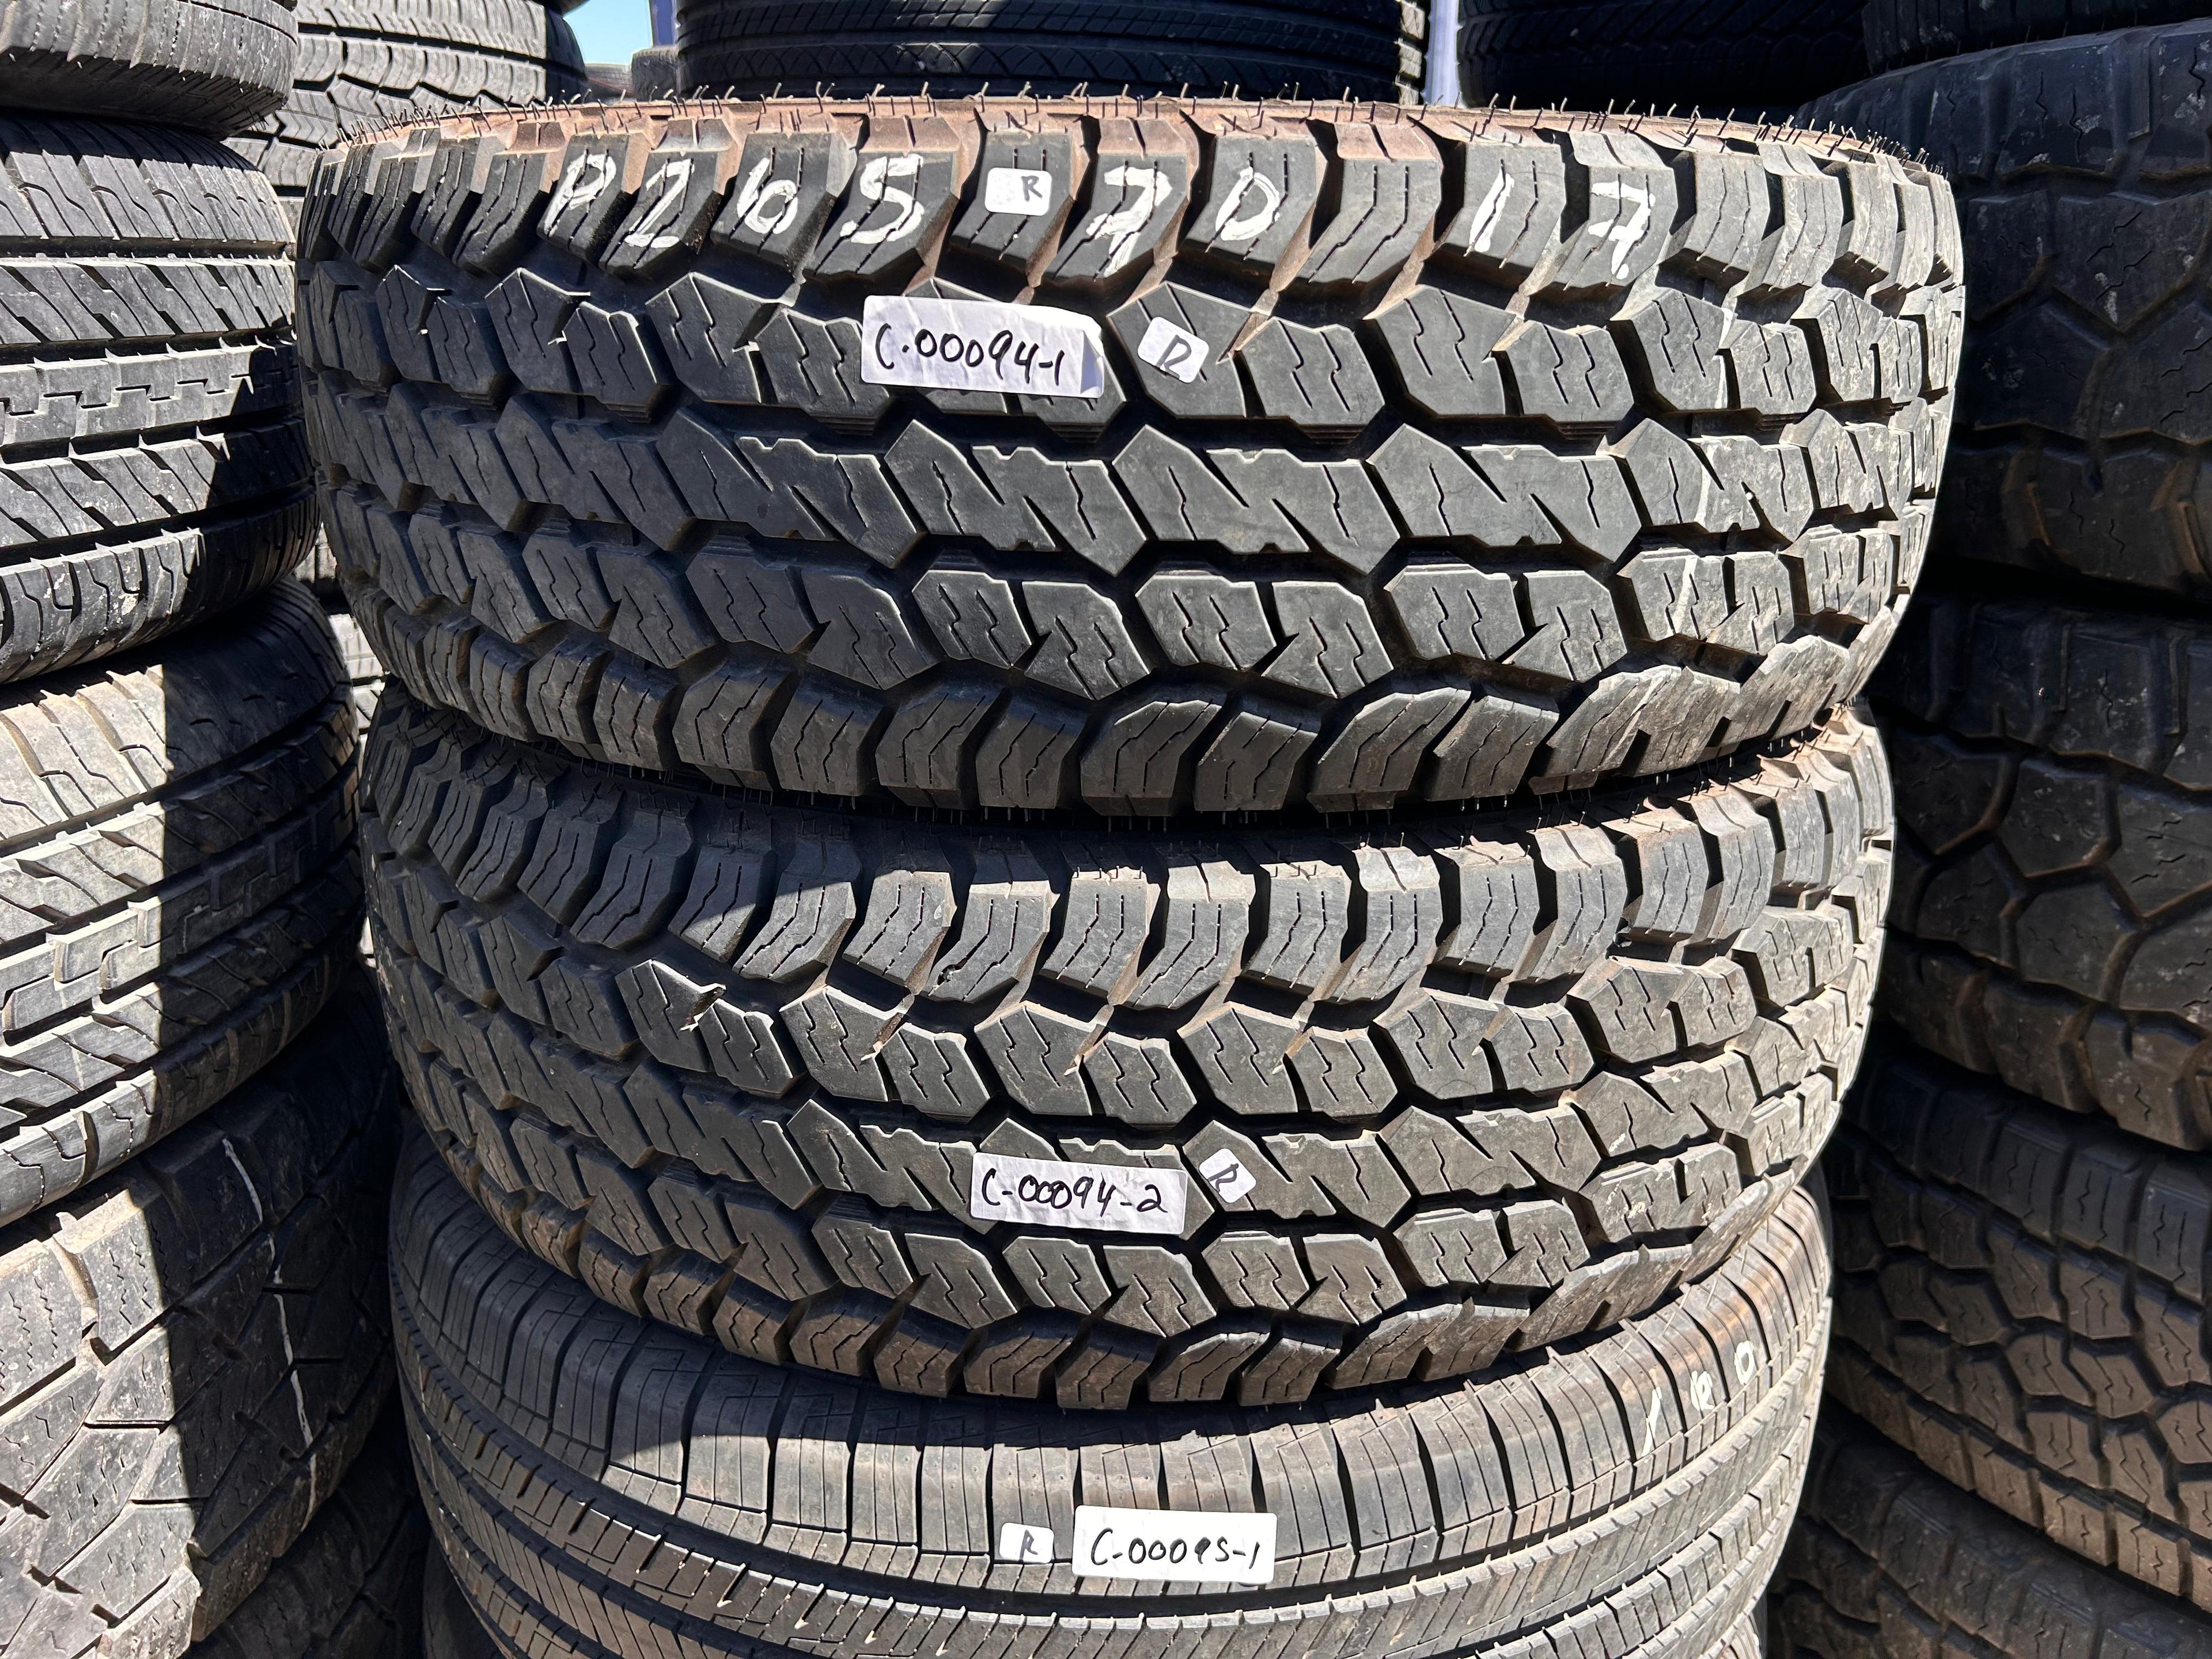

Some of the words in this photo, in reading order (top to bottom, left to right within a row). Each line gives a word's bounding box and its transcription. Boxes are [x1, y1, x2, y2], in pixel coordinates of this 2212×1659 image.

[1021, 175, 1043, 201] R
[544, 154, 925, 248] P265
[1086, 165, 1281, 277] 70
[1469, 171, 1655, 279] 17
[982, 1168, 1167, 1216] C-00094-2
